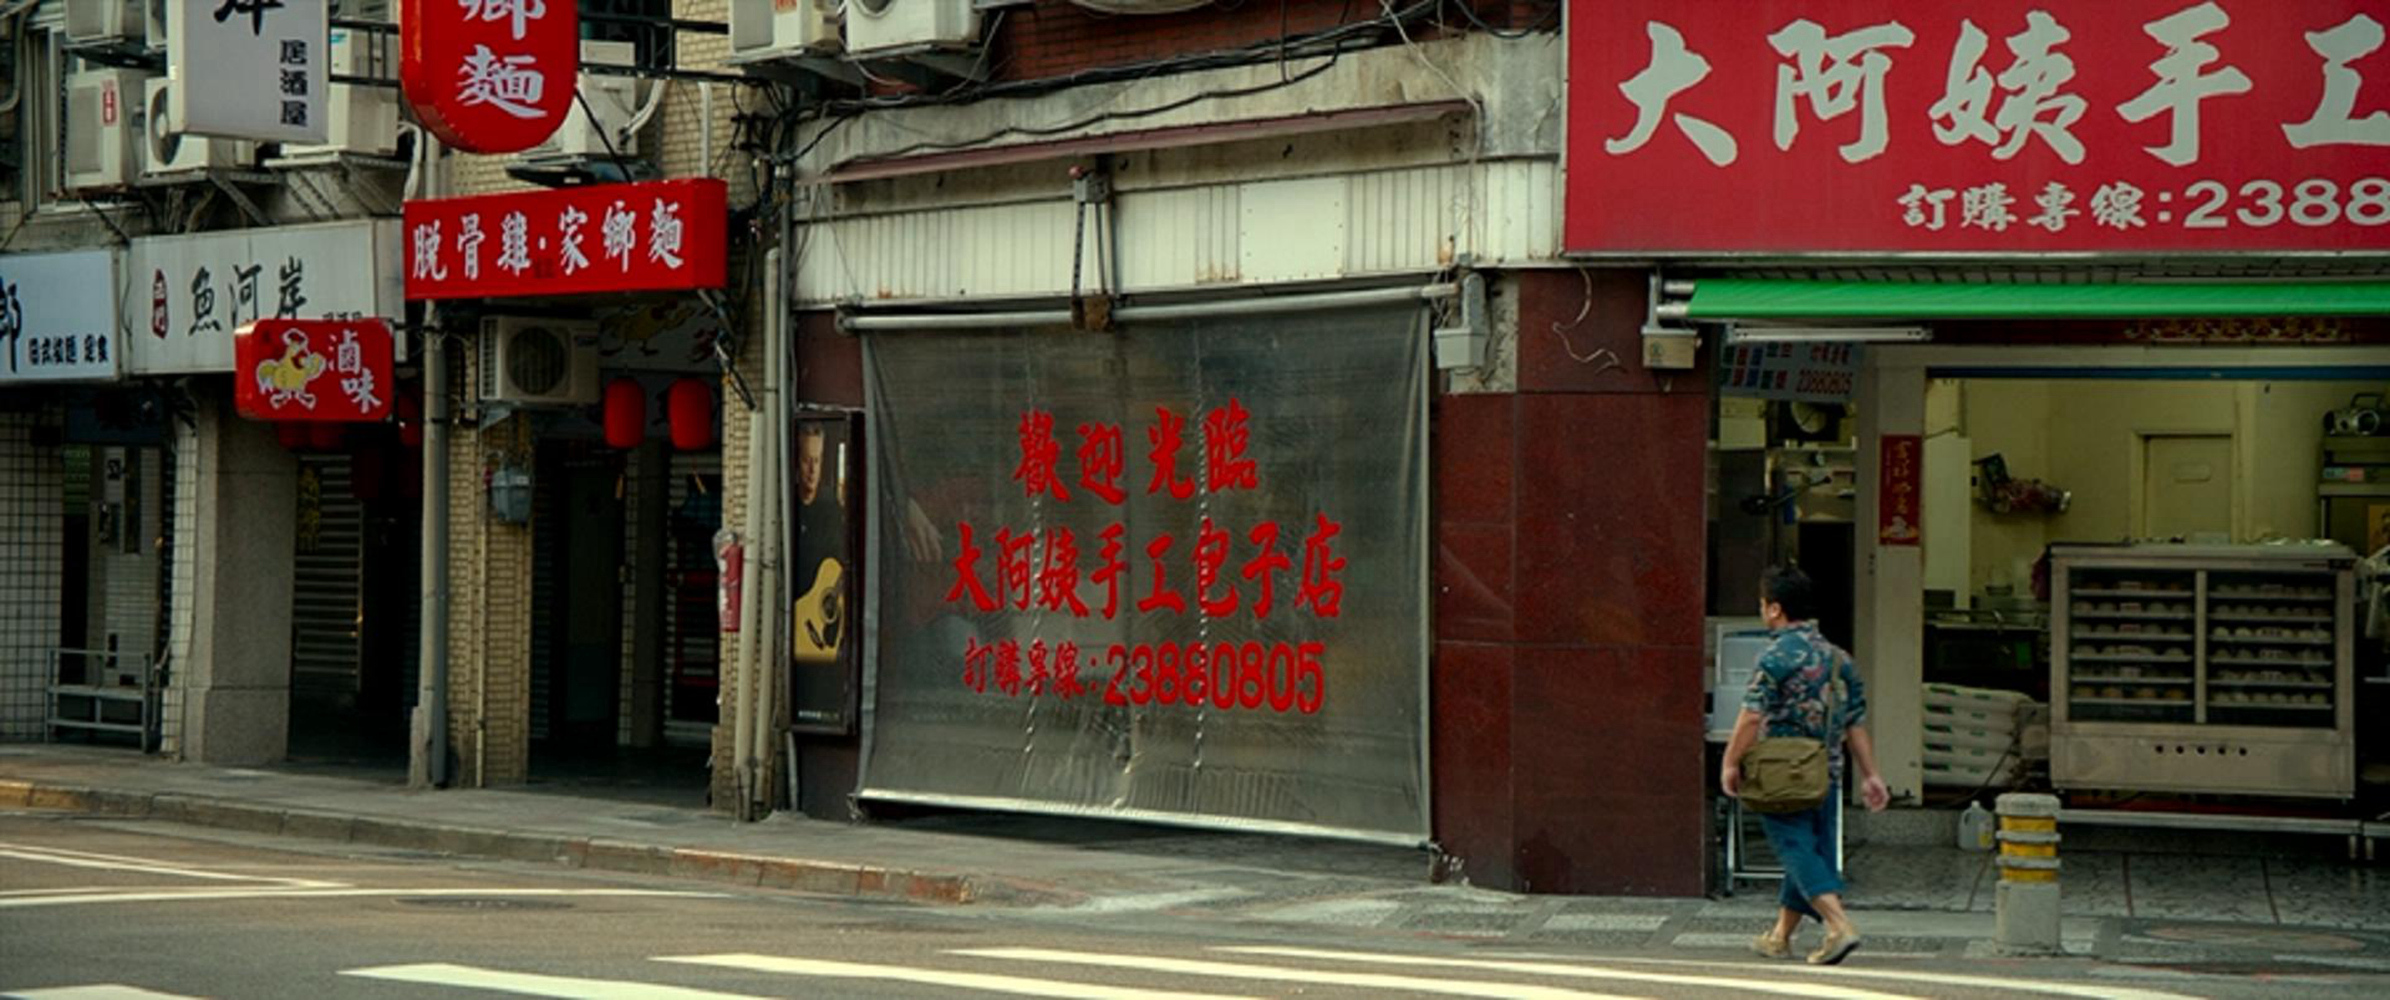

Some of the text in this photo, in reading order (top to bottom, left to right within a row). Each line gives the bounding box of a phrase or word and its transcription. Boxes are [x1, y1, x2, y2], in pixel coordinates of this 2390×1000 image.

[327, 328, 382, 414] 滷味
[1013, 397, 1259, 505] 歡迎光臨
[946, 511, 1348, 619] 大阿姨手工包子店
